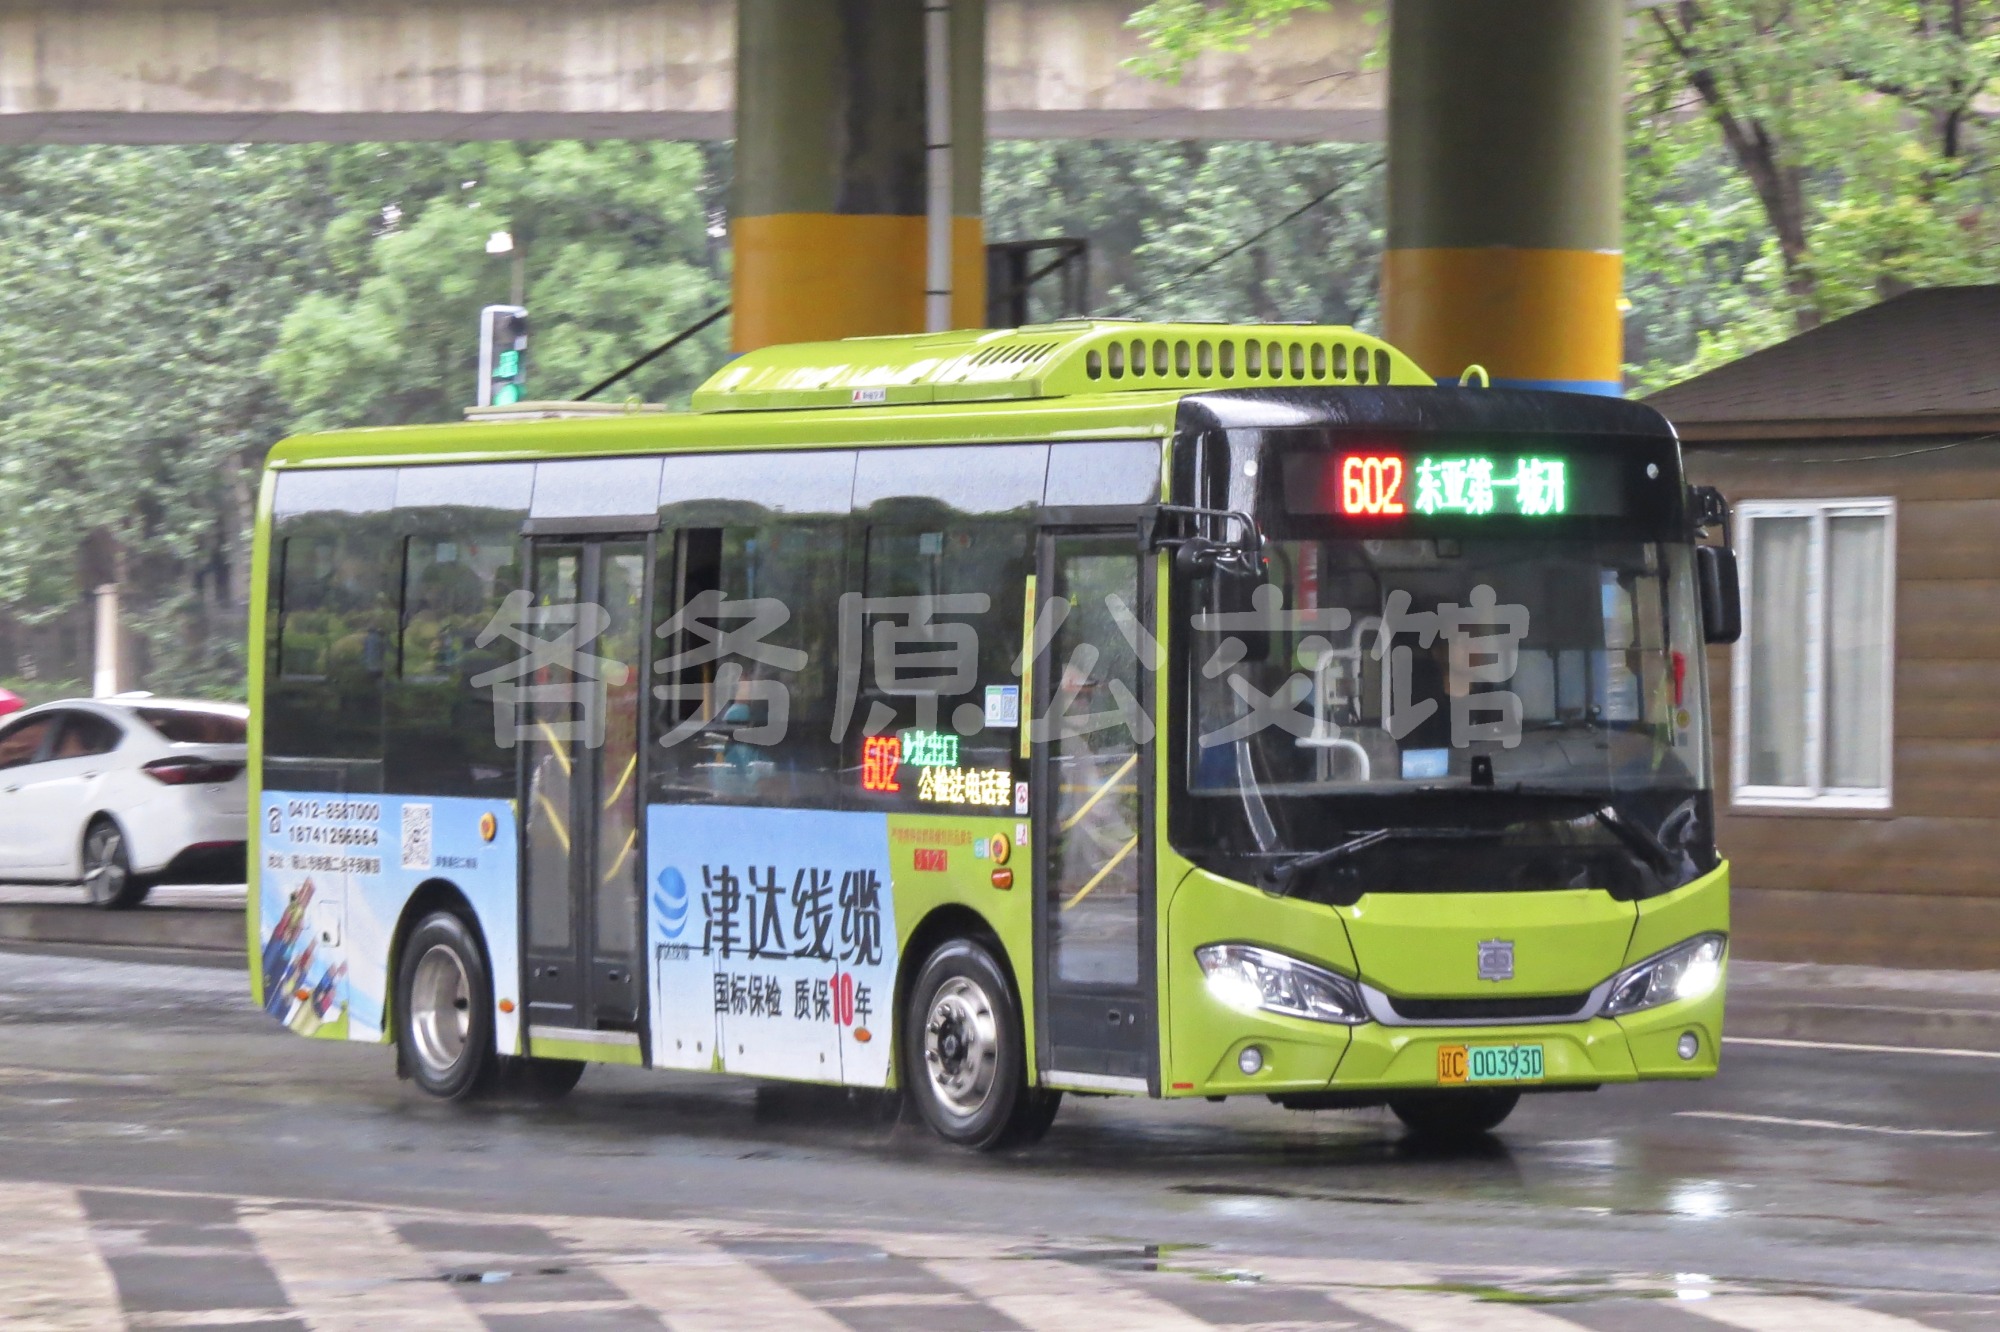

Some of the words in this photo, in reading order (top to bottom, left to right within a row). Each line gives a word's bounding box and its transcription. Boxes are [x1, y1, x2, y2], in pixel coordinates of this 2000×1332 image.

[1342, 456, 1404, 514] 602
[862, 735, 901, 792] 602
[917, 765, 1012, 806] 公检法电话要
[701, 864, 883, 966] 津达线缆
[713, 972, 782, 1018] 国标保检
[793, 972, 873, 1027] 质保10年
[1473, 1049, 1542, 1077] 00393D
